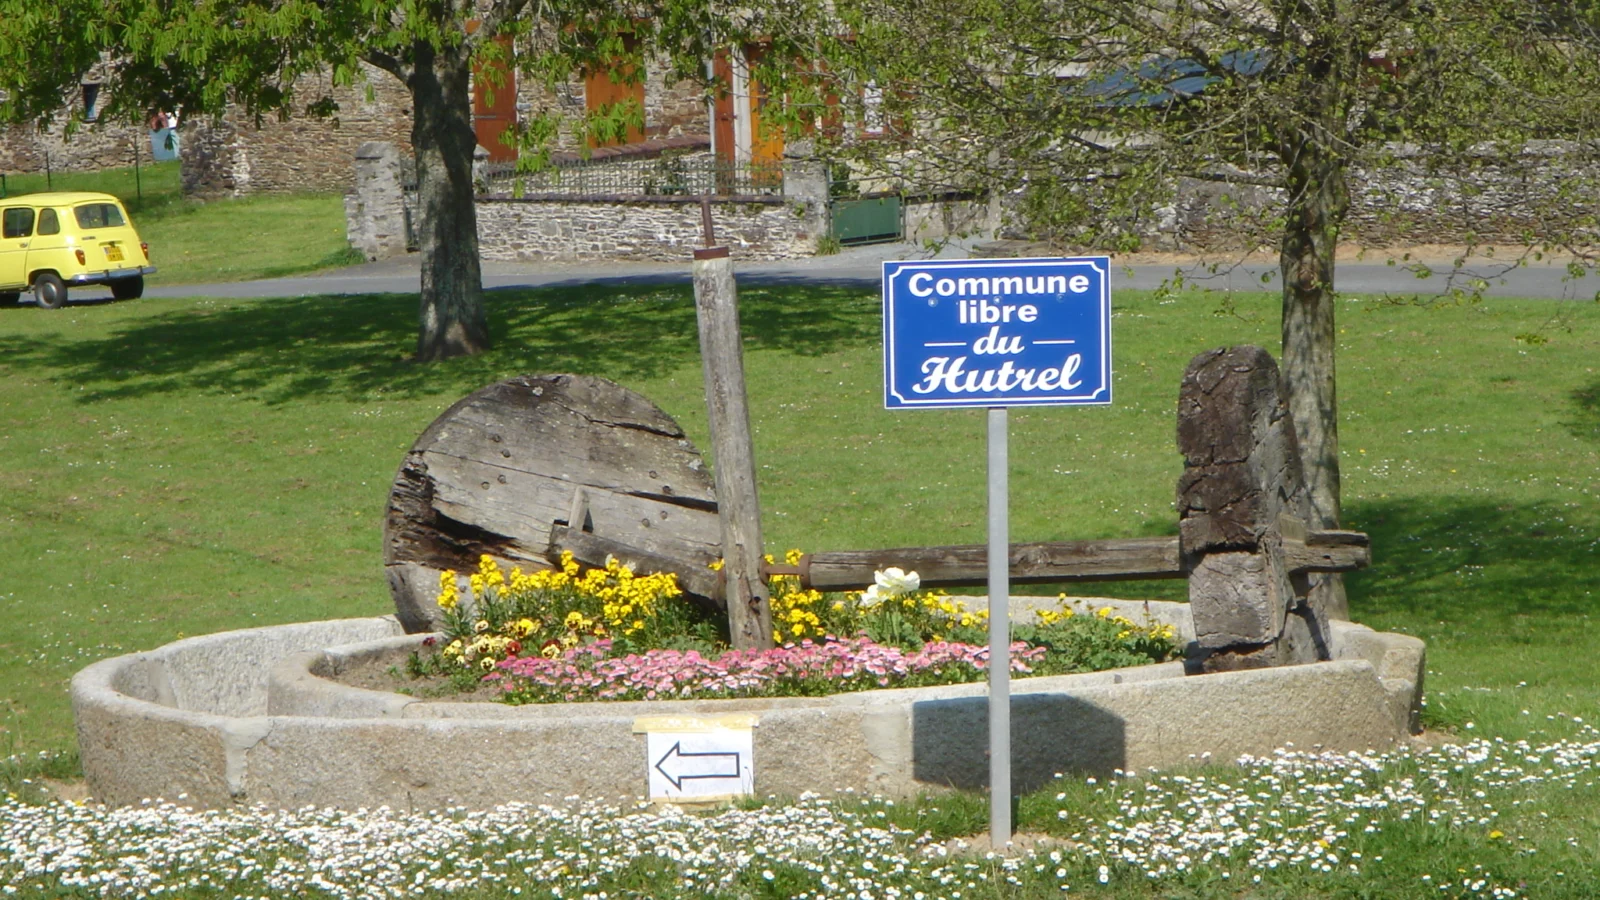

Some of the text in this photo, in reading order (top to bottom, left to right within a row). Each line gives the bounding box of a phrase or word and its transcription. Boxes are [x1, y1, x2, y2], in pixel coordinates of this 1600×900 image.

[908, 273, 1089, 297] Commune
[959, 300, 1038, 324] libre
[972, 326, 1025, 355] du
[912, 353, 1083, 394] Hutrel
